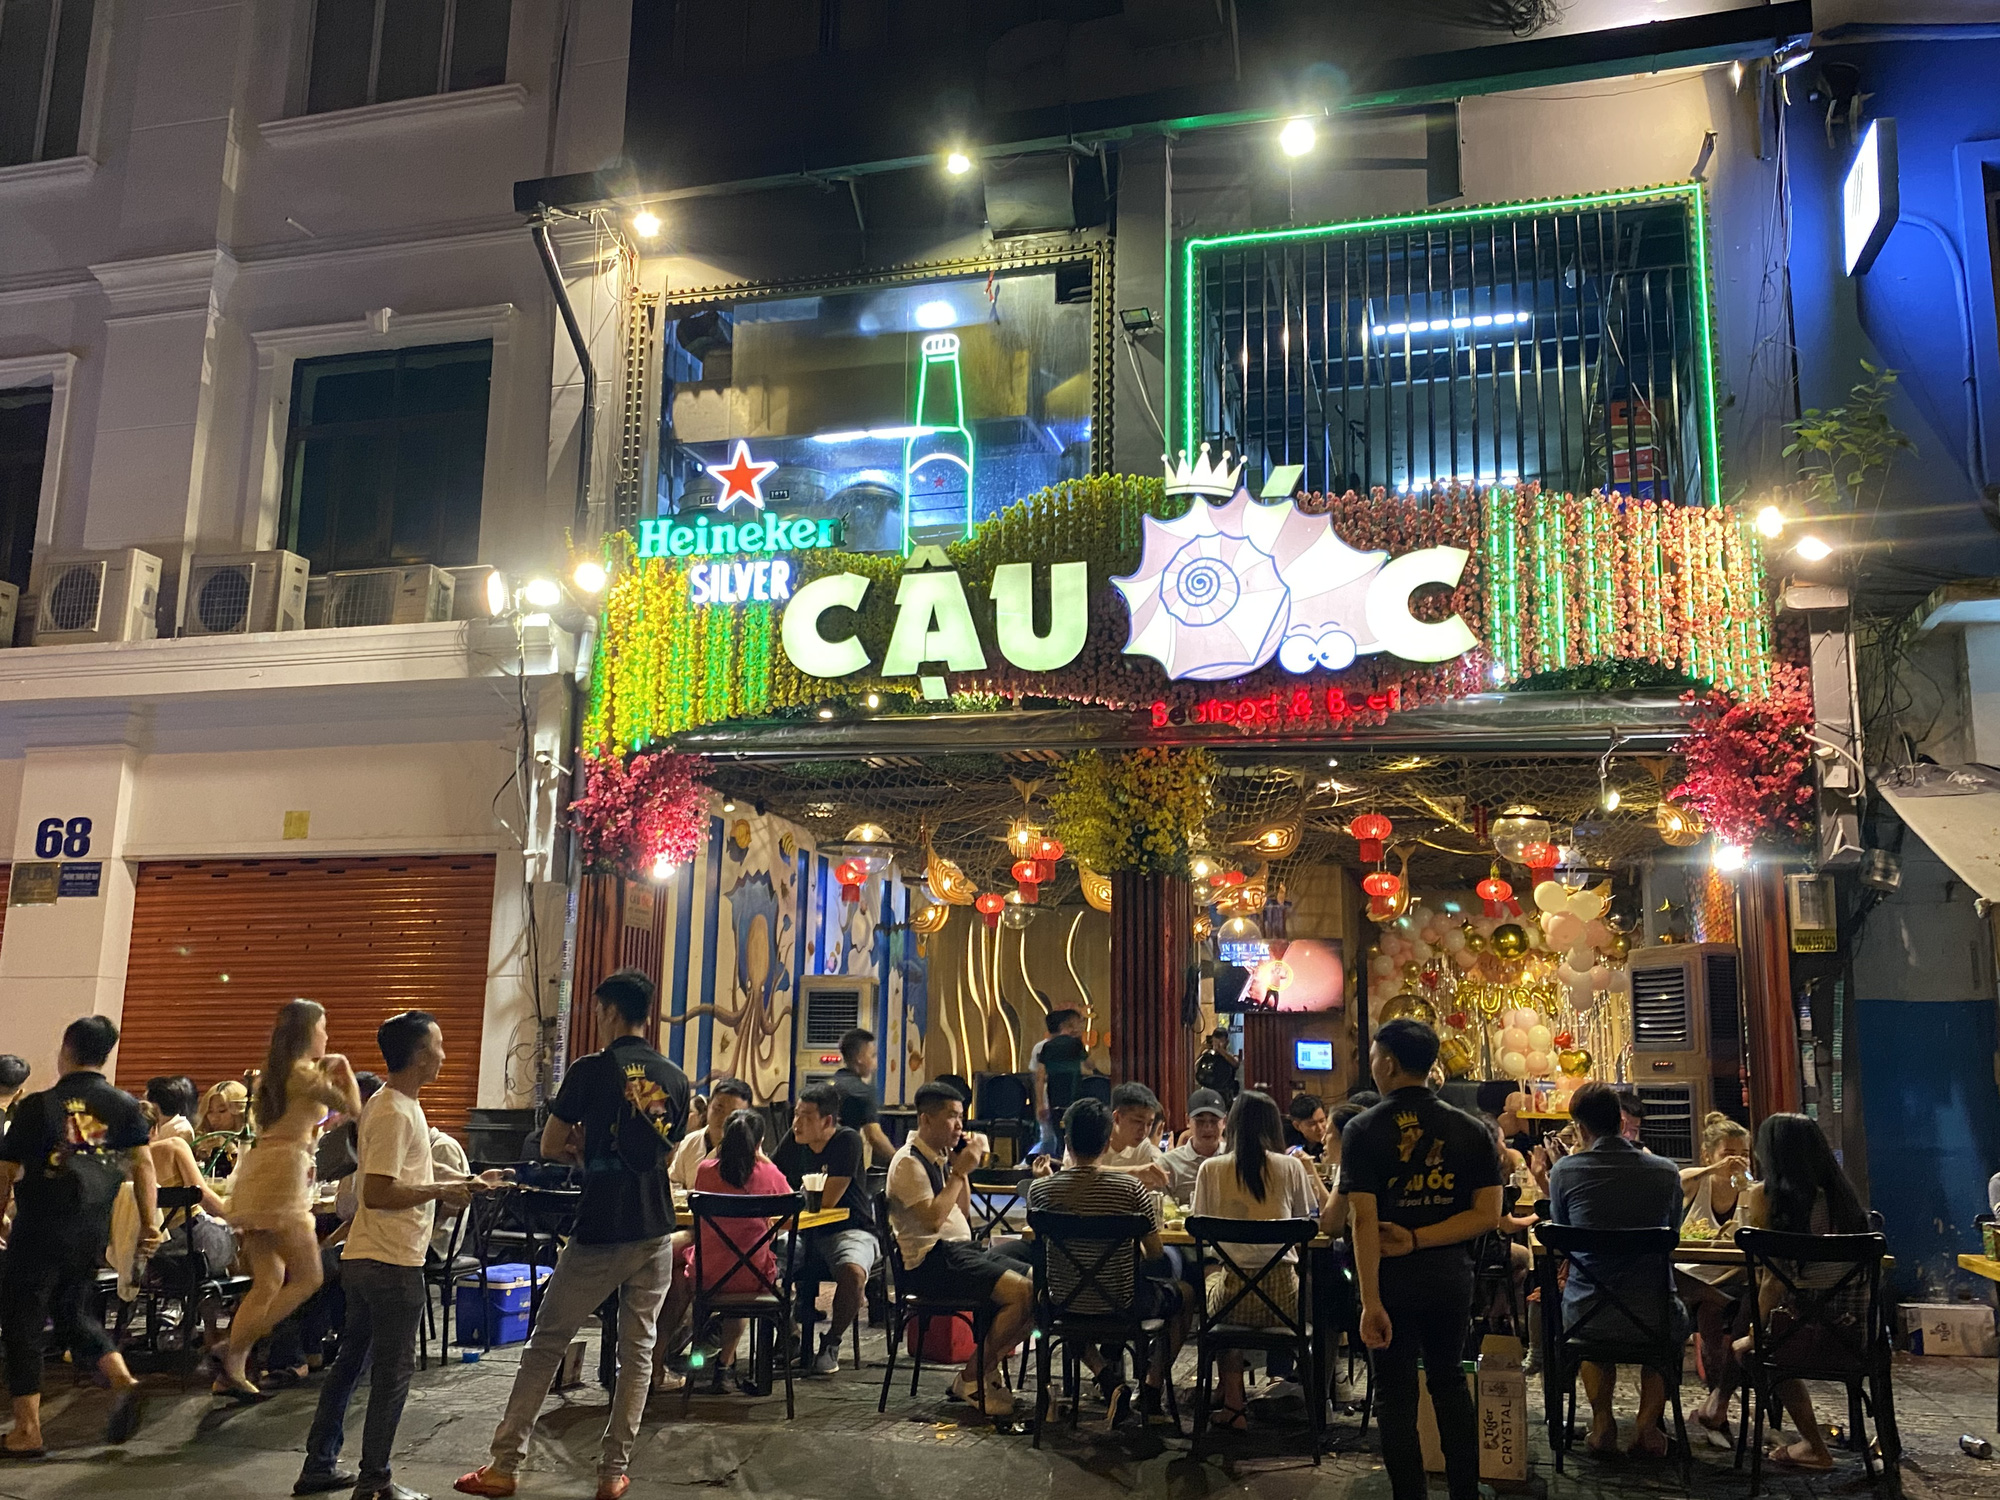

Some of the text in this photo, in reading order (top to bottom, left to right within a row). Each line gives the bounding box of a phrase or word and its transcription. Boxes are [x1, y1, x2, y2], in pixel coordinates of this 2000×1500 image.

[638, 512, 849, 558] Heineken
[690, 560, 790, 604] SILVER
[781, 545, 1088, 700] CẬU
[1291, 690, 1313, 716] &
[35, 817, 92, 858] 68
[1484, 1409, 1498, 1437] Tiger
[1501, 1400, 1513, 1465] CRYSTAL
